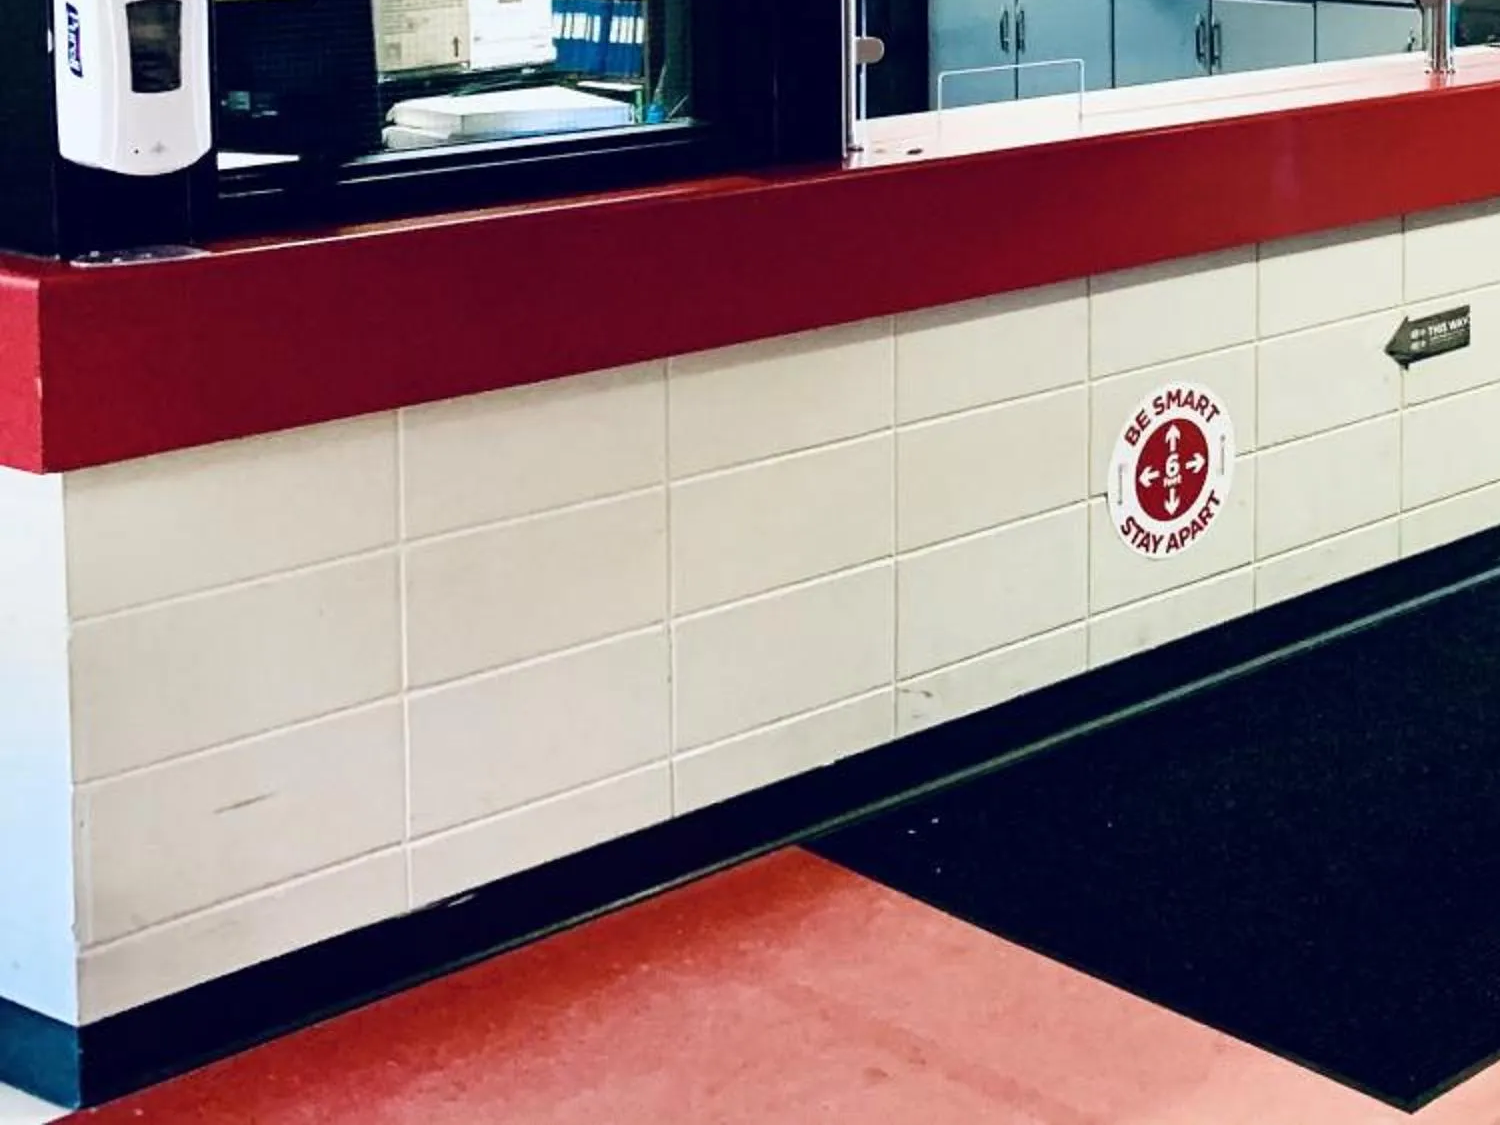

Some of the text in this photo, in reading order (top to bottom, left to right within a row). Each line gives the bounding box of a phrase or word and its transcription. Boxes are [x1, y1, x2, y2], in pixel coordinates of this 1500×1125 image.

[1124, 388, 1220, 446] BE SMART
[1165, 453, 1180, 477] 6
[1120, 489, 1220, 554] STAY APART
